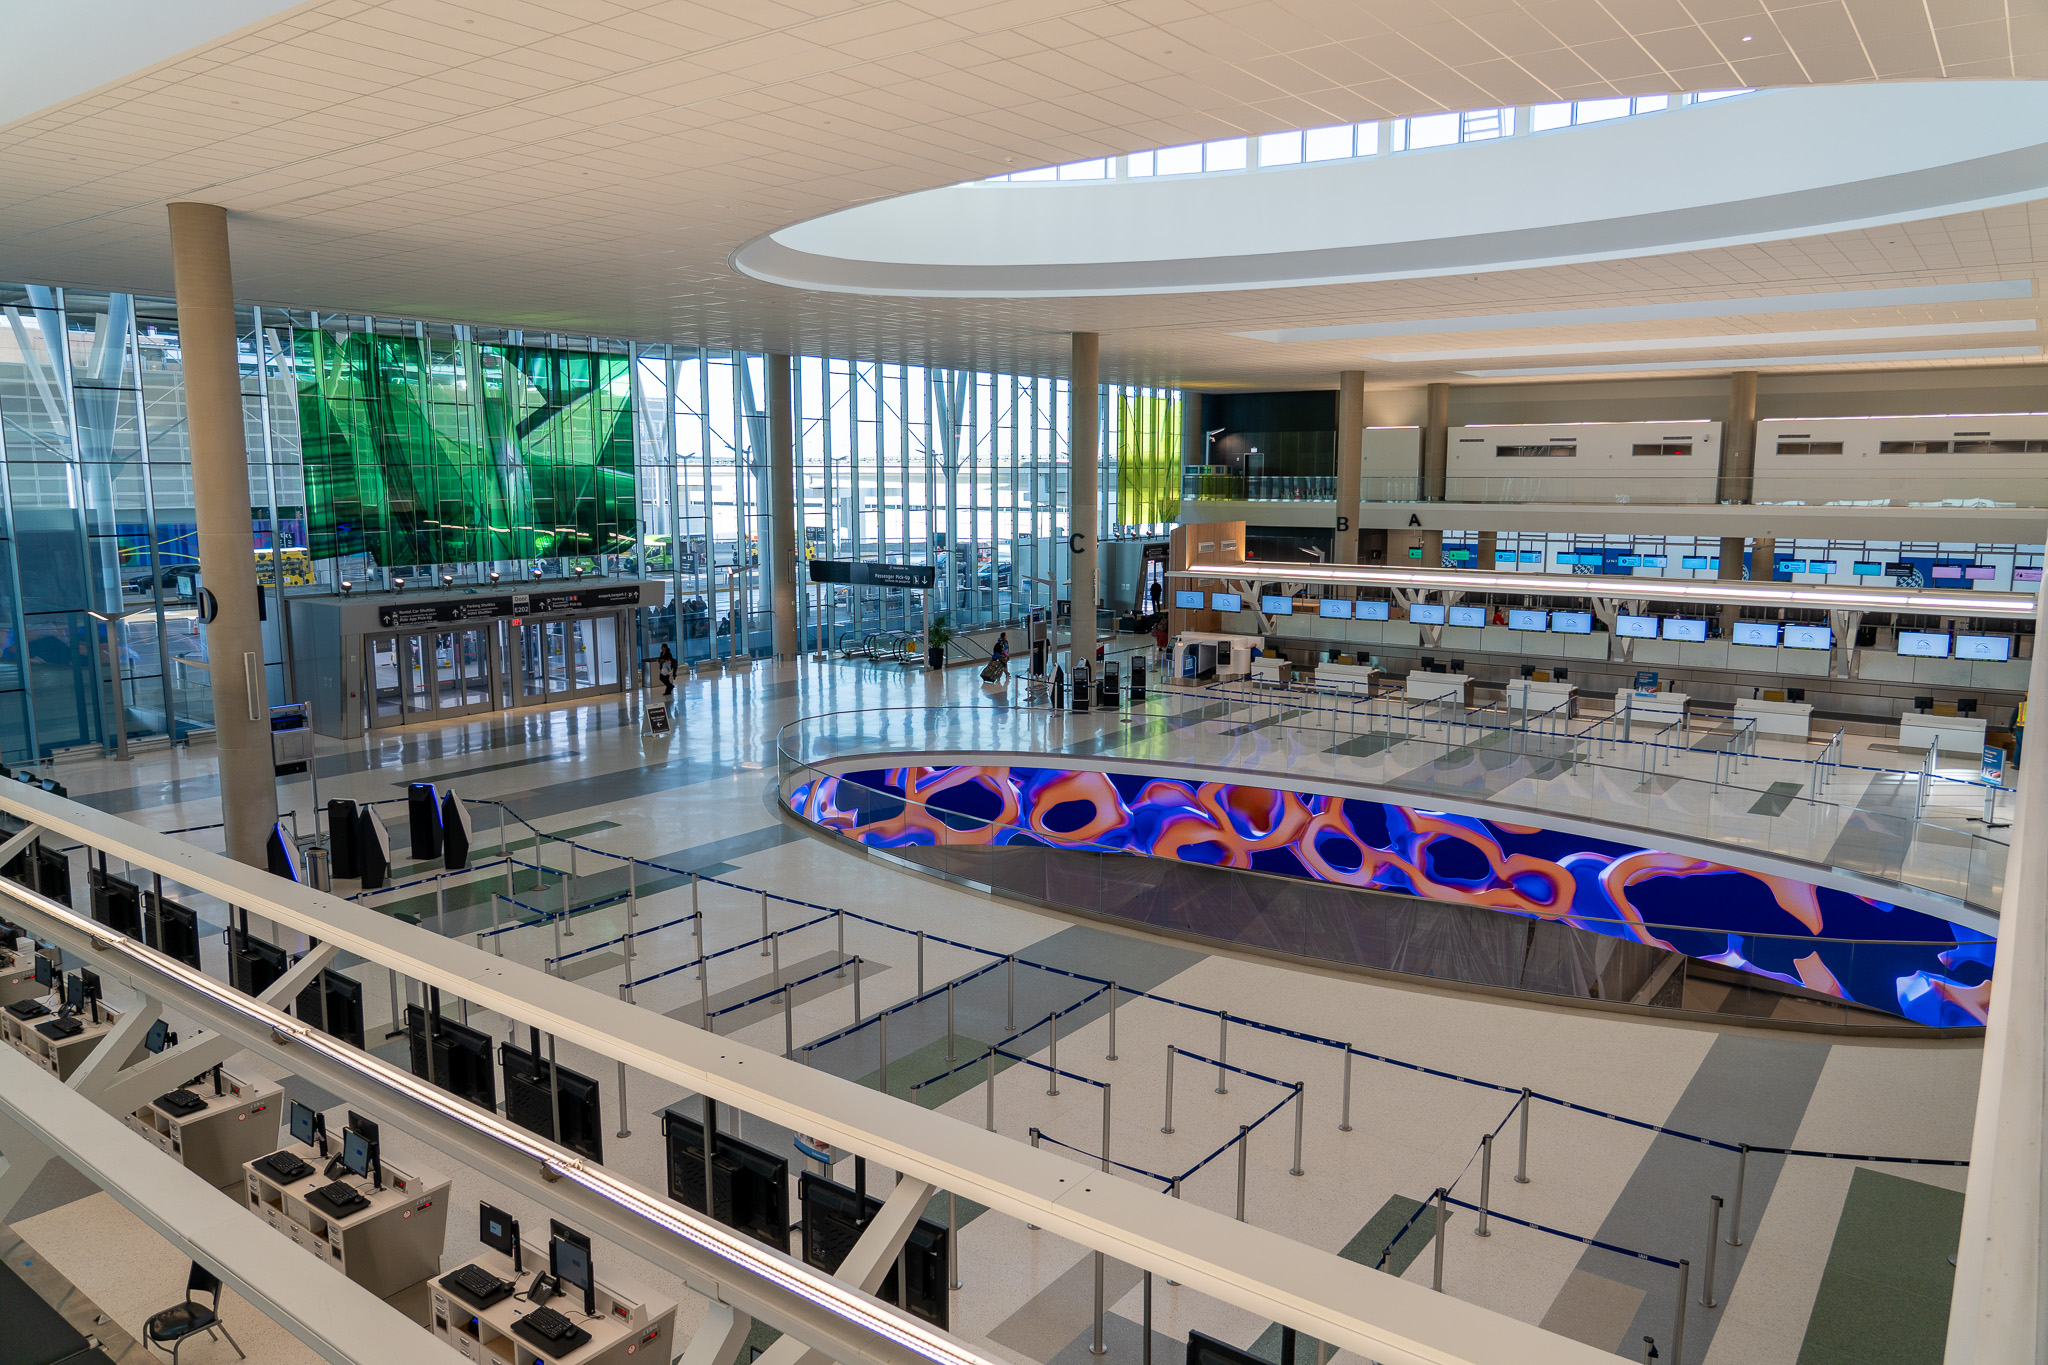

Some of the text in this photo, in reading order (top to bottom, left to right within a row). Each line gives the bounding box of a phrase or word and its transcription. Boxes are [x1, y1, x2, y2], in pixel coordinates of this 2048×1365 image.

[1336, 516, 1350, 532] B
[1408, 513, 1421, 527] A
[1069, 532, 1086, 554] C
[196, 587, 218, 625] D
